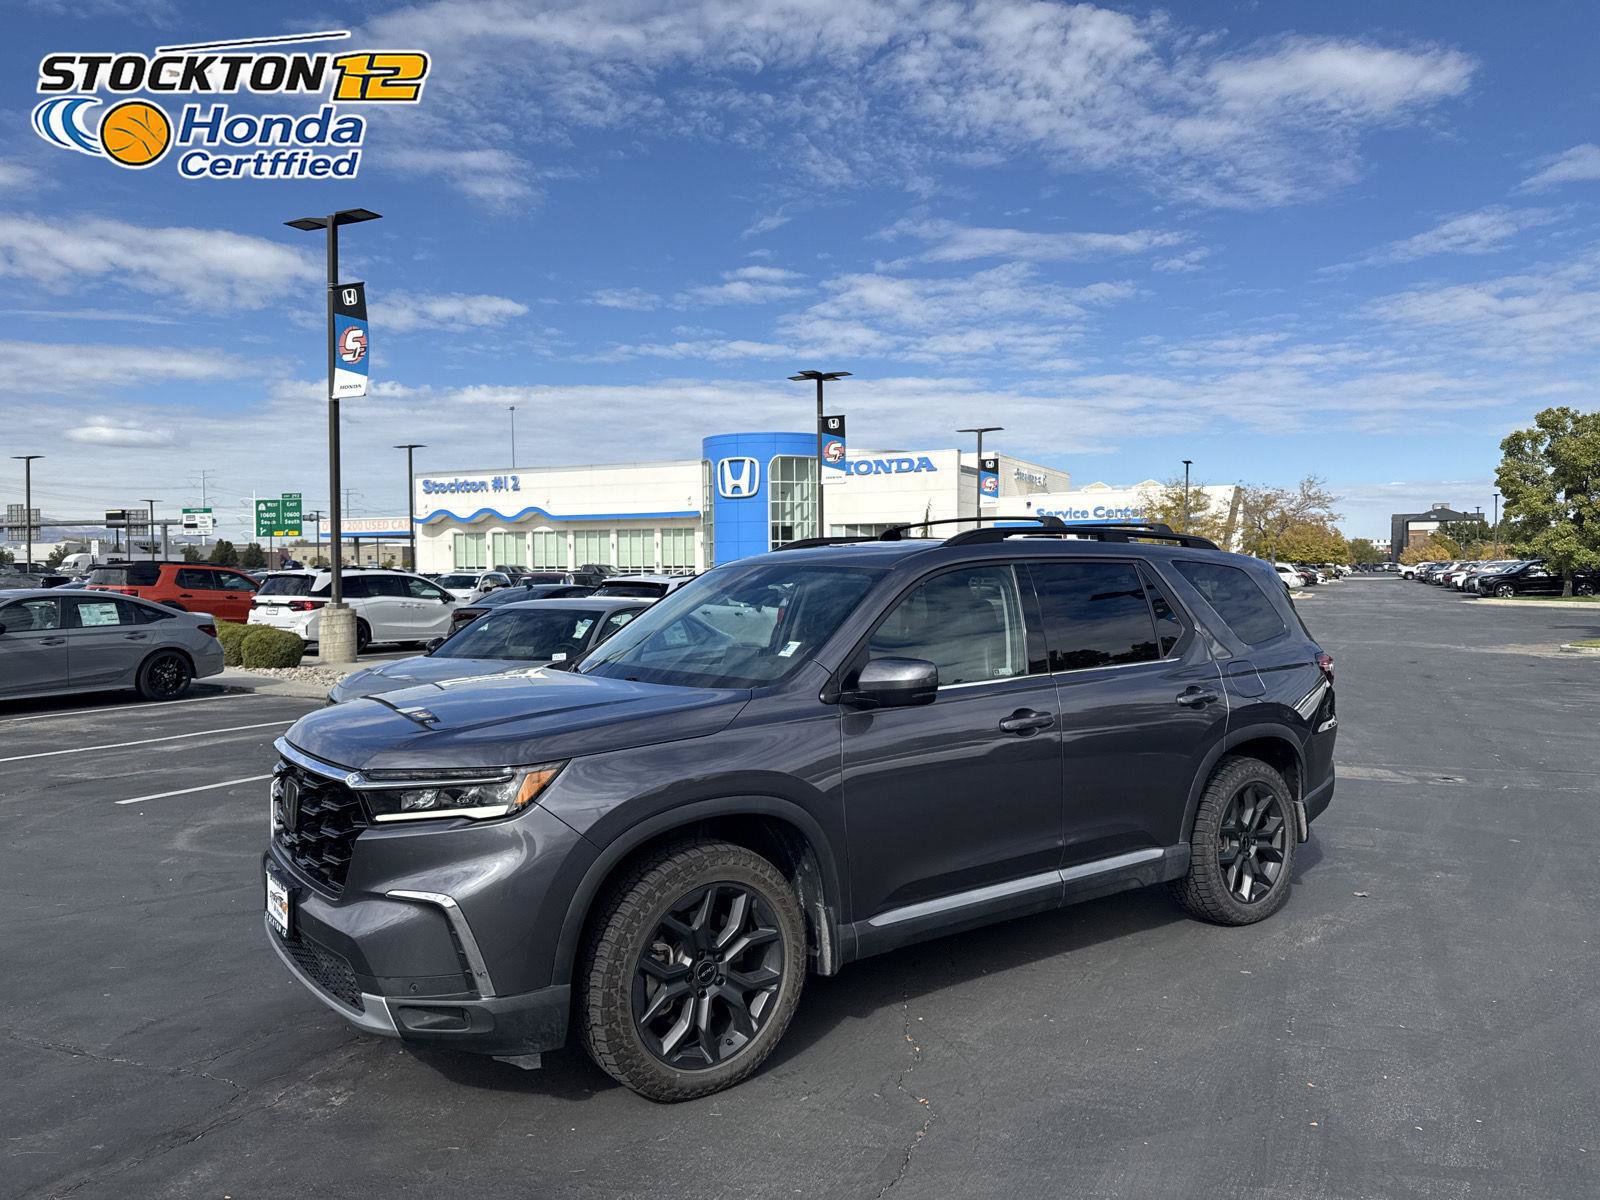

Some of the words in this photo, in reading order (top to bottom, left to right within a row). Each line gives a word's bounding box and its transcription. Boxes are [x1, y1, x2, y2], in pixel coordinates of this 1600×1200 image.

[422, 478, 489, 494] Stockton
[1036, 506, 1089, 519] Service
[366, 520, 389, 530] USED
